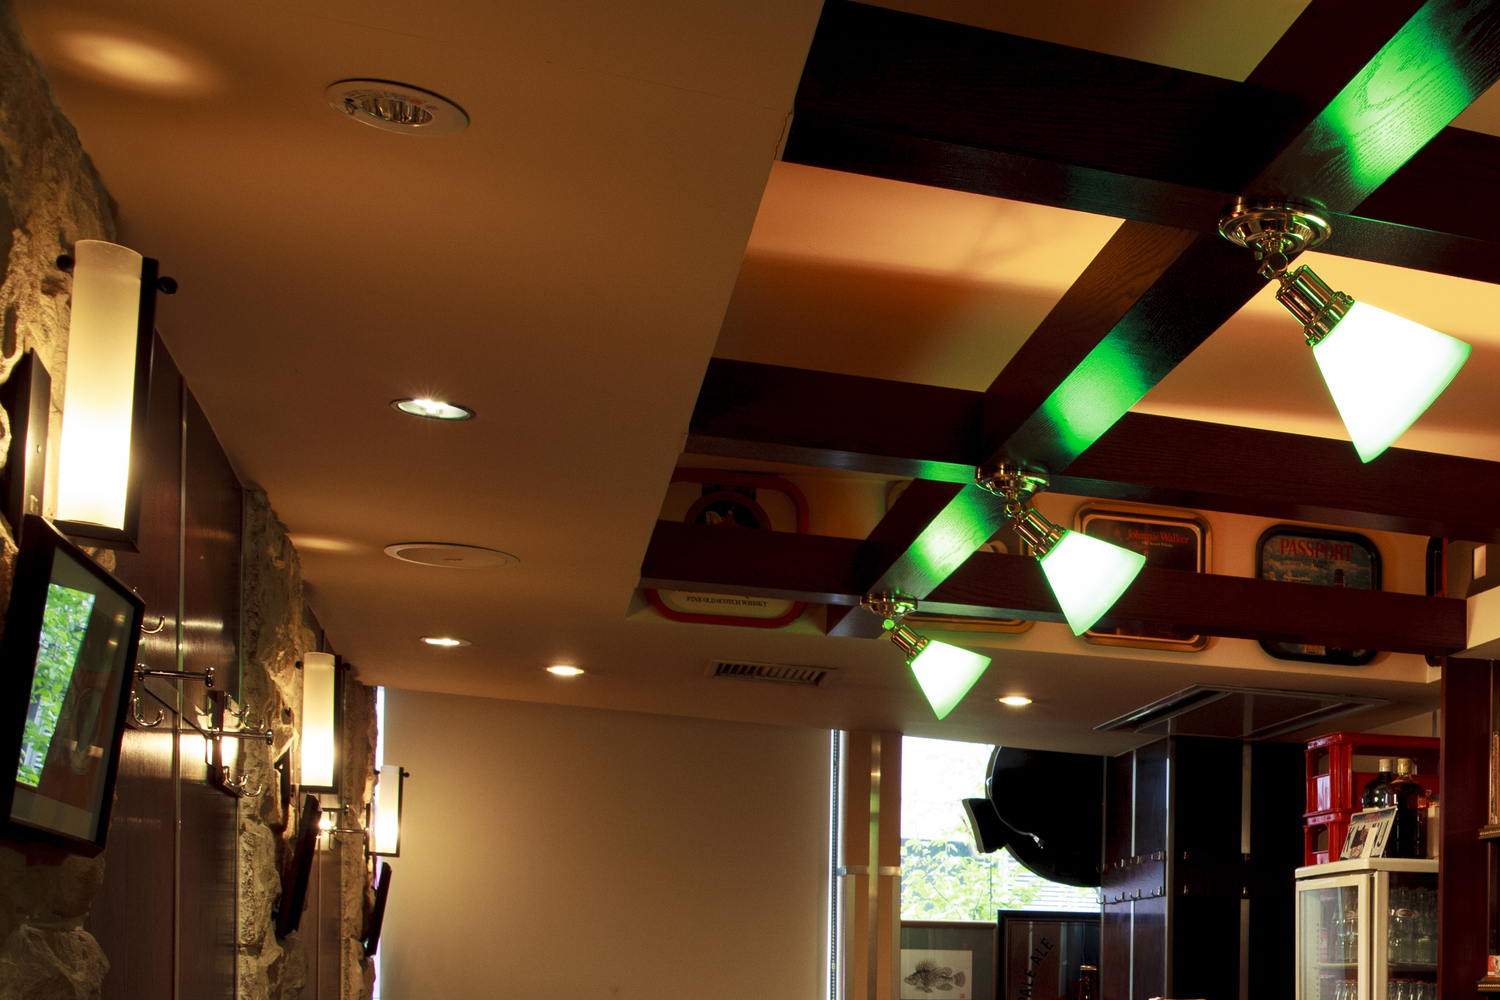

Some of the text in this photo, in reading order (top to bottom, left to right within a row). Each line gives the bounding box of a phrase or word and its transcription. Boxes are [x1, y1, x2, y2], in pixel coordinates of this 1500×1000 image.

[1127, 529, 1189, 544] Johnnie Walker
[1280, 538, 1353, 561] PASSPORT
[1030, 938, 1054, 966] ALE
